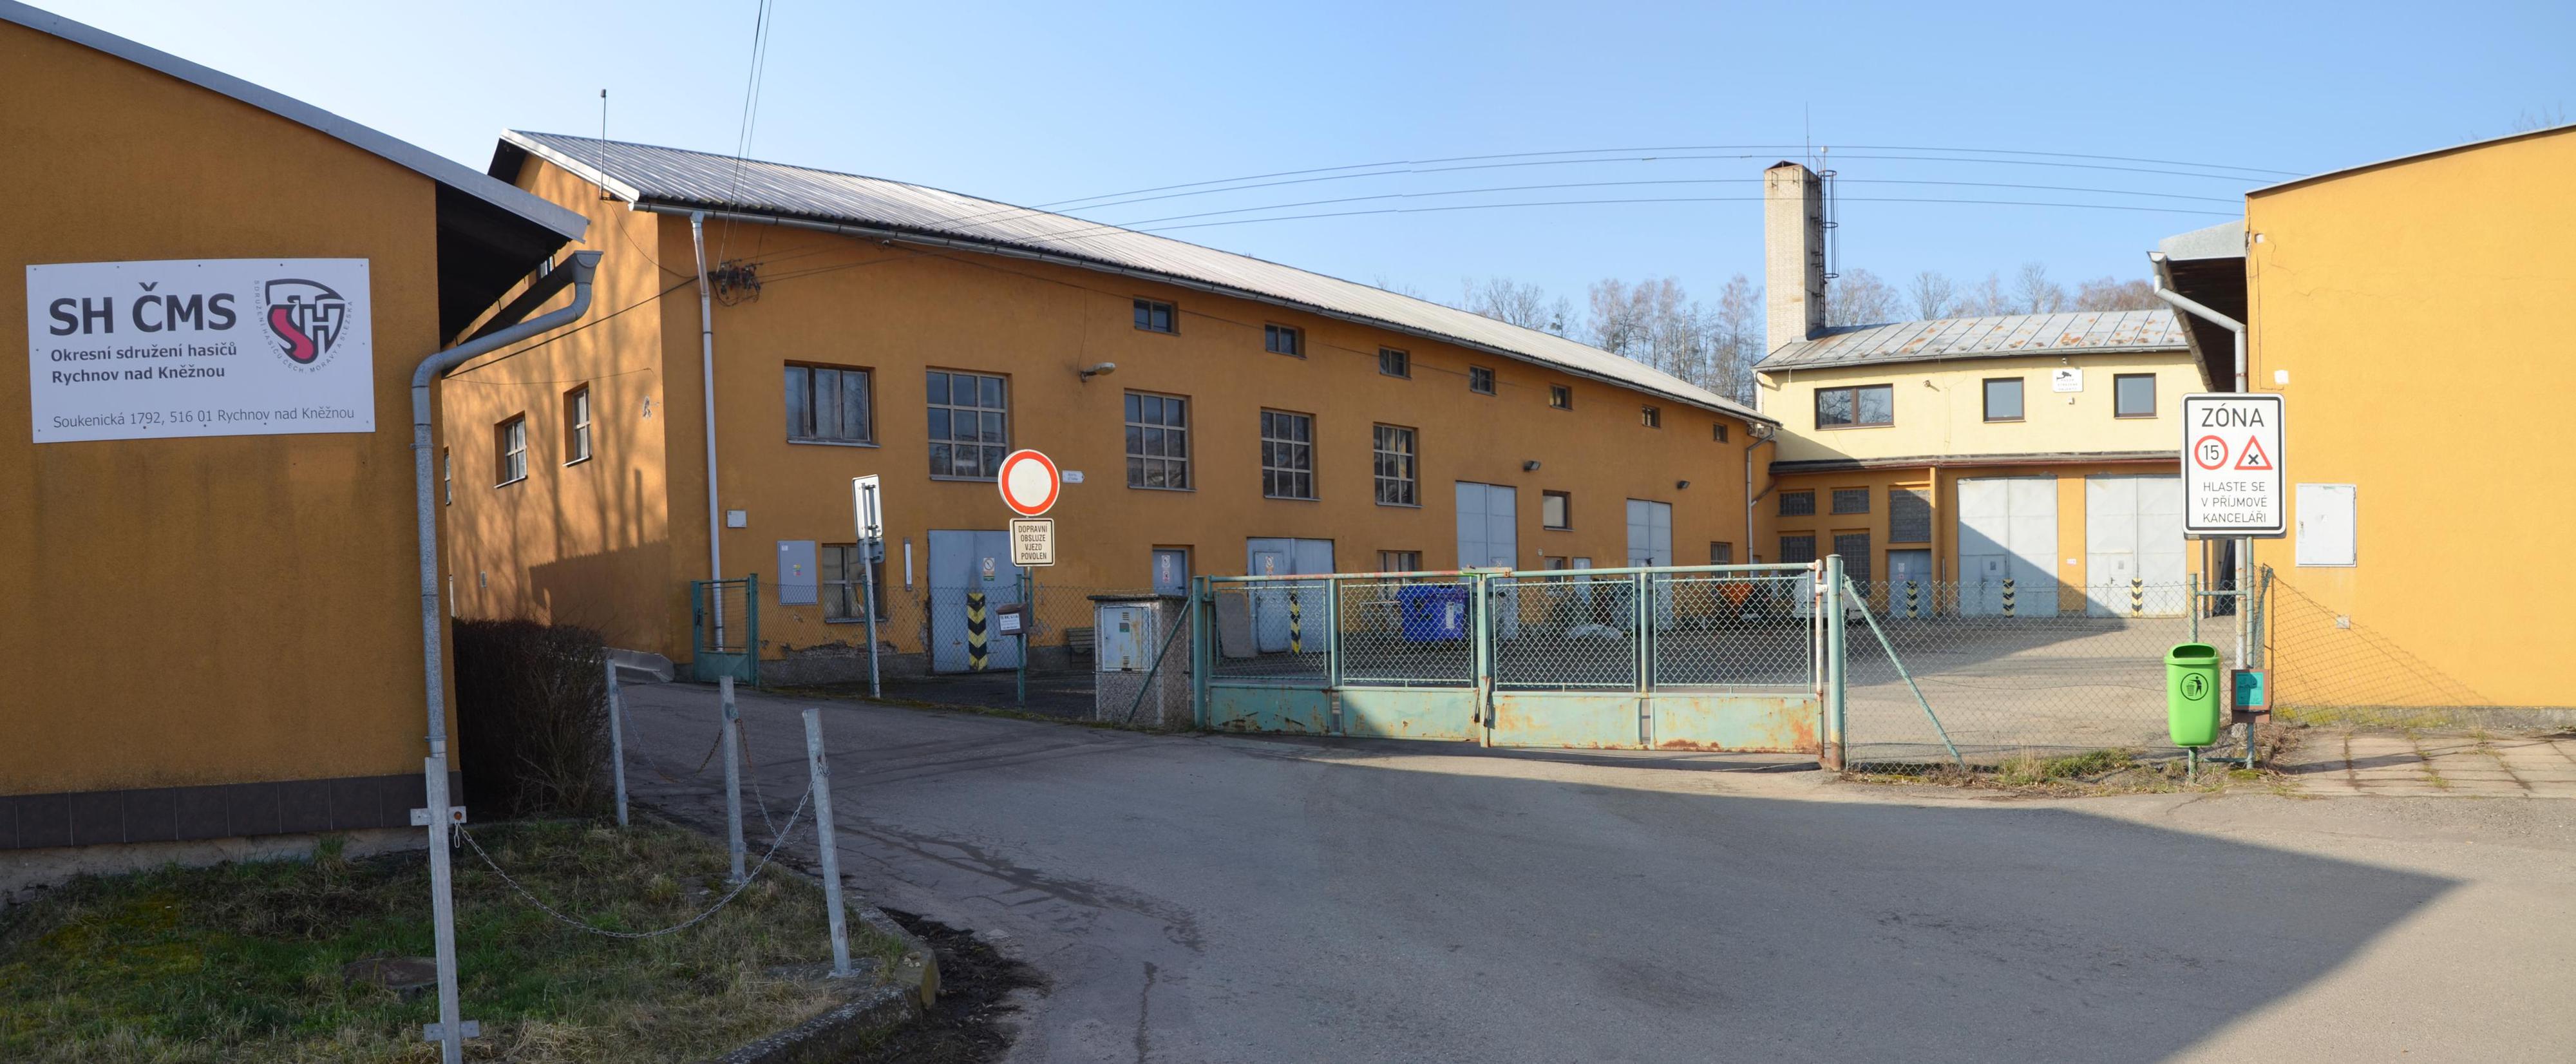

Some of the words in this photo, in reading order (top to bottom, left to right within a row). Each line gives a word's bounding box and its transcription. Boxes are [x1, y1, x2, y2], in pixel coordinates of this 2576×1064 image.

[49, 296, 114, 336] SH
[132, 281, 237, 333] ČMS
[51, 346, 111, 362] Okresní
[116, 344, 182, 359] sdružení
[188, 341, 237, 357] hasičů
[52, 369, 119, 386] Rychnov
[124, 366, 153, 380] nad
[158, 364, 225, 379] Kněžnou
[53, 412, 125, 428] Soukenická
[131, 412, 165, 426] 1792,
[170, 410, 193, 423] 516
[197, 410, 212, 423] 01
[218, 409, 270, 424] Rychnov
[275, 408, 297, 420] nad
[302, 406, 354, 419] Kněžnou
[2201, 403, 2265, 428] ZÓNA
[2203, 444, 2219, 461] 15
[2203, 481, 2247, 492] HLASTE
[2251, 481, 2266, 492] SE
[2201, 497, 2208, 508] V
[2212, 495, 2268, 508] PŘÍJMOVÉ
[2203, 510, 2266, 523] KANCELÁŘI
[1018, 524, 1048, 533] DOPRAVNÍ
[1020, 534, 1046, 542] OBSLUZE
[1021, 552, 1047, 560] POVOLEN
